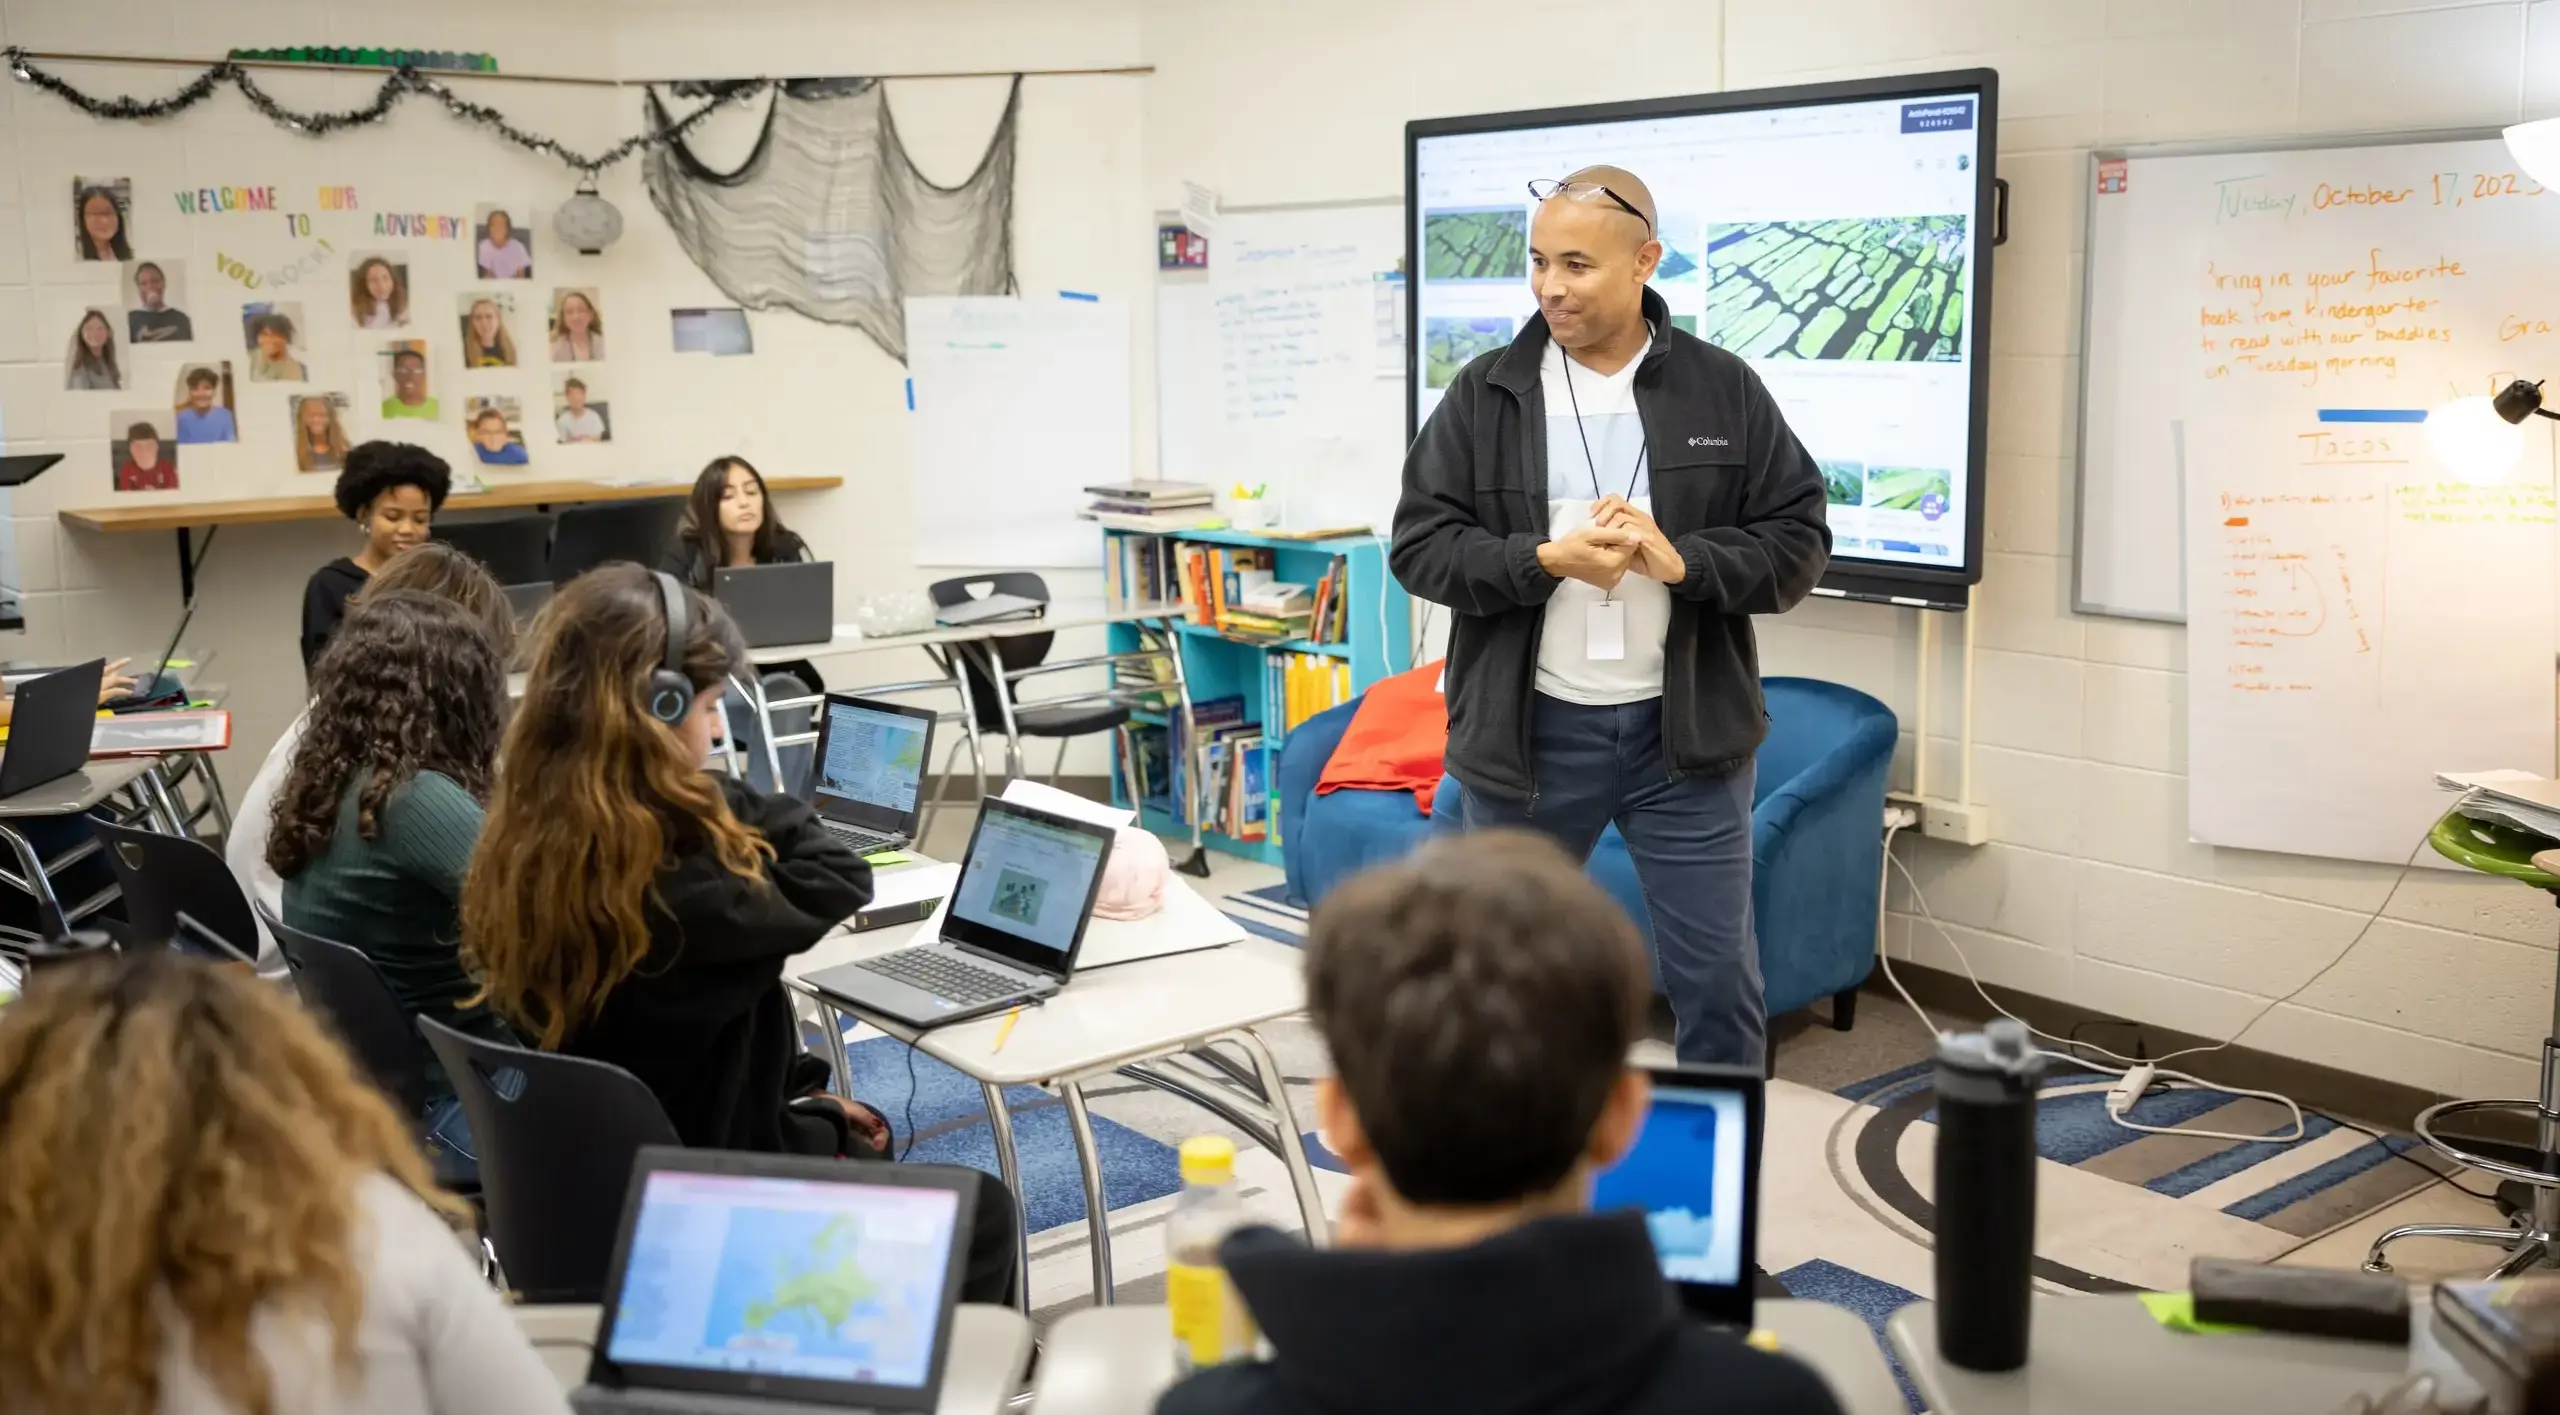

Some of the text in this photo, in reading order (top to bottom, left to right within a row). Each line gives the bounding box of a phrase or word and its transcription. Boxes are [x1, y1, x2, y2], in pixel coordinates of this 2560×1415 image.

[174, 185, 468, 240] WELCOME TO OUR ADVISORY!
[2313, 182, 2413, 210] October
[2432, 173, 2462, 207] 17,
[216, 238, 336, 290] YOU ROCK!
[2270, 271, 2292, 288] in
[2307, 270, 2356, 303] your
[2366, 247, 2466, 293] favorite
[2331, 333, 2363, 343] our
[1696, 437, 1728, 446] Columbia
